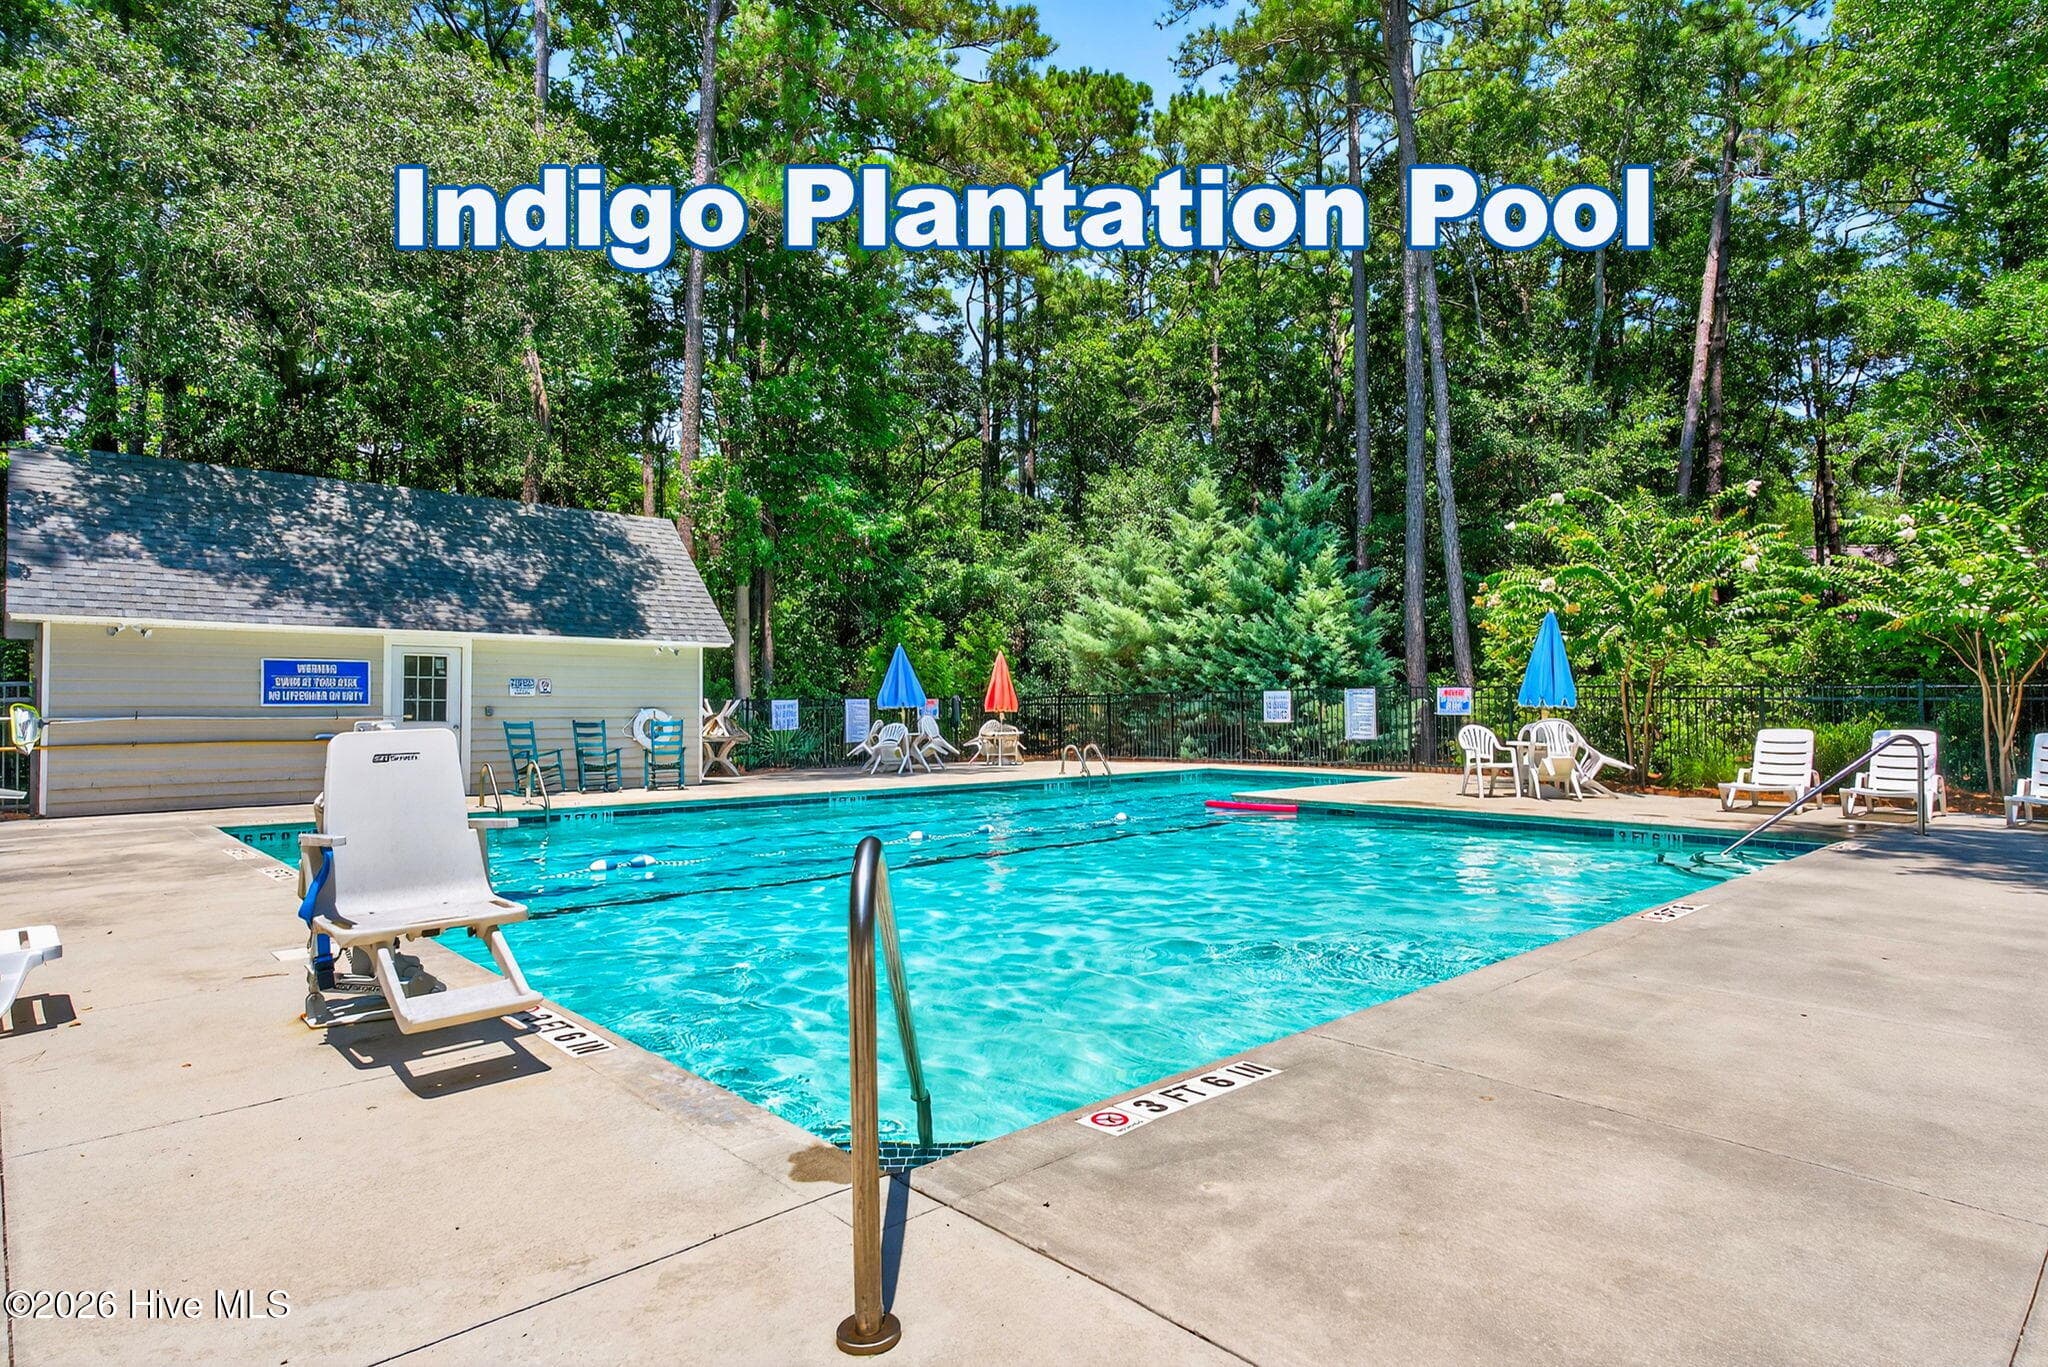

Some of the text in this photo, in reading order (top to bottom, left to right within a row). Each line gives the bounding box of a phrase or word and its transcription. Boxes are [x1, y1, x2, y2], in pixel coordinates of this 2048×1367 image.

[539, 1020, 574, 1033] FT
[554, 1032, 587, 1042] 6
[566, 1040, 610, 1055] IN
[1133, 1063, 1272, 1112] 3 FT 6 IN
